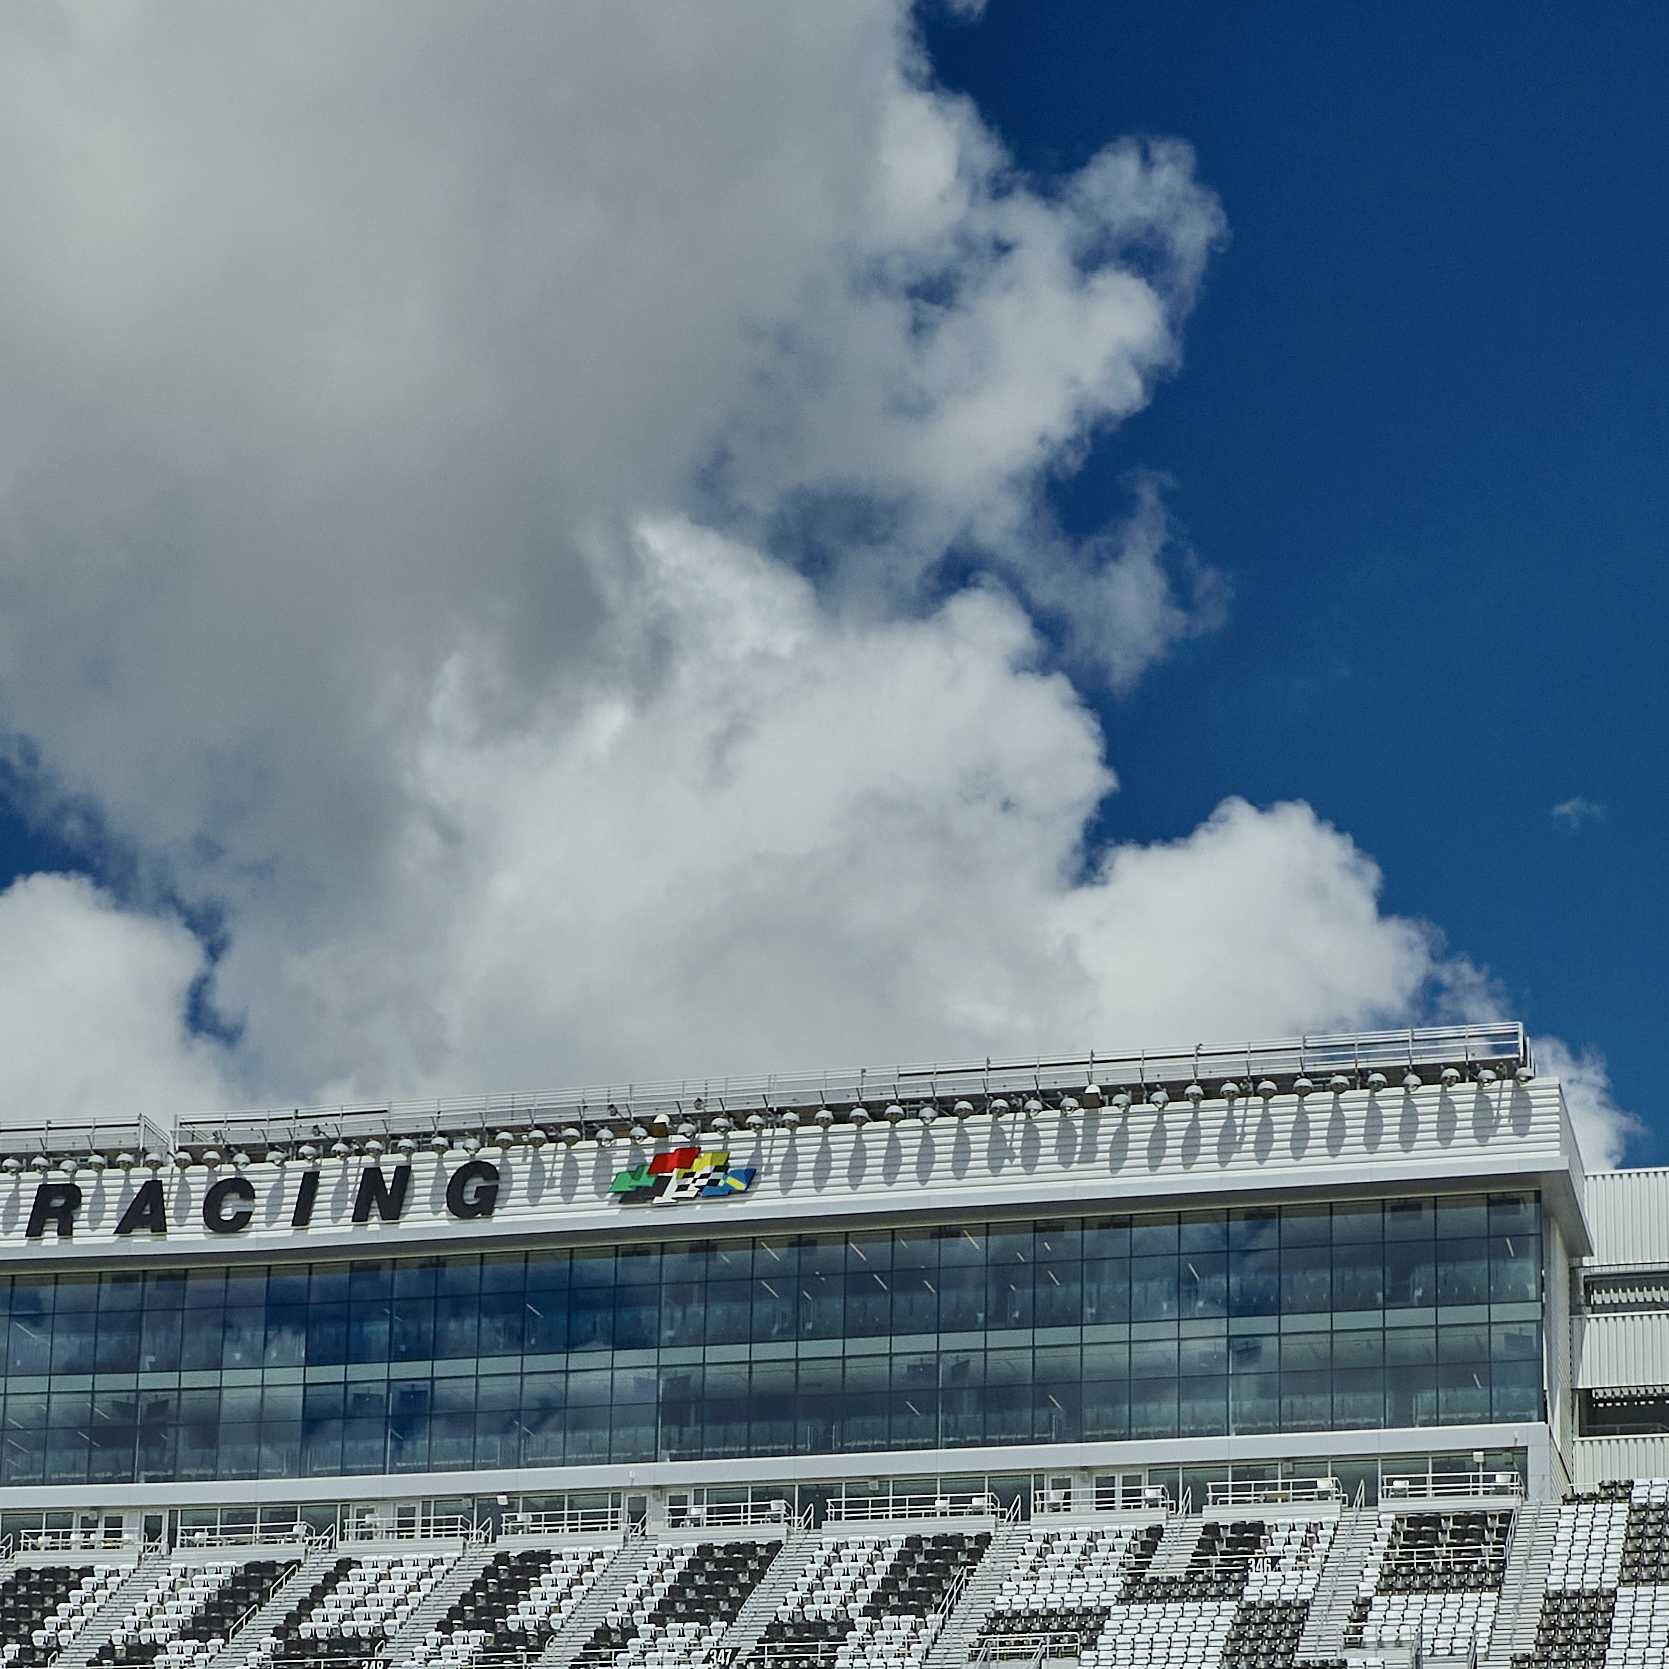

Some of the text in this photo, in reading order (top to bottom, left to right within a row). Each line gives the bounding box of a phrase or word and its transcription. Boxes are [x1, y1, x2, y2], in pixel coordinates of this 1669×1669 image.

[24, 1160, 501, 1238] RACING
[1247, 1558, 1271, 1573] 346
[710, 1649, 731, 1665] 347
